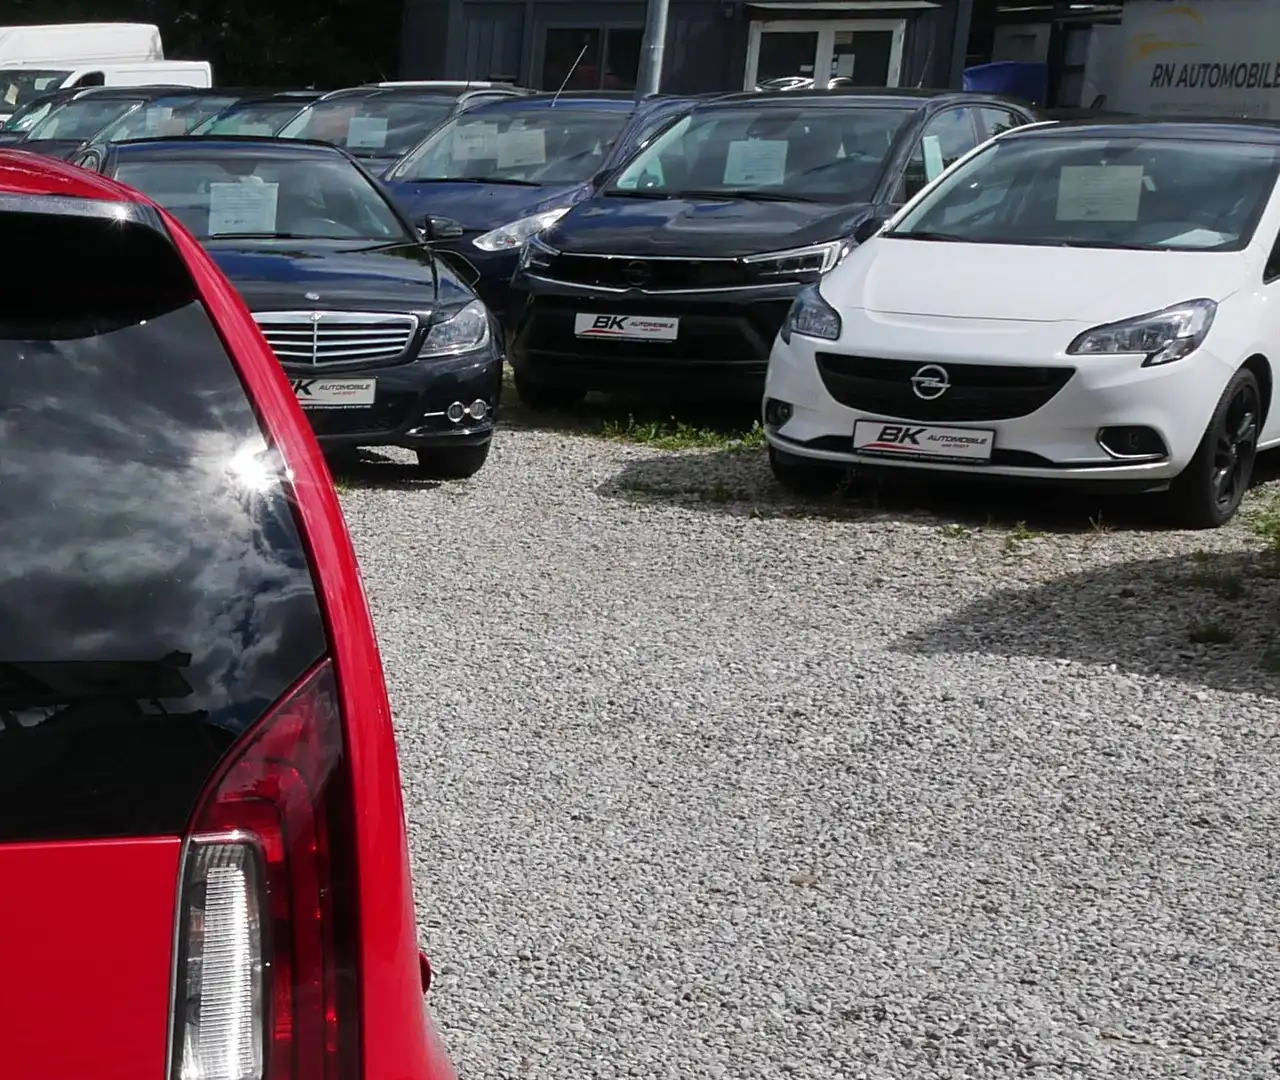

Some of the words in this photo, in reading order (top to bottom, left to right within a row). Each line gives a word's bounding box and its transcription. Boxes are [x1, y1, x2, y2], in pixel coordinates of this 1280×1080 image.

[1150, 63, 1176, 88] RN
[592, 315, 630, 330] BK
[877, 425, 928, 445] BK
